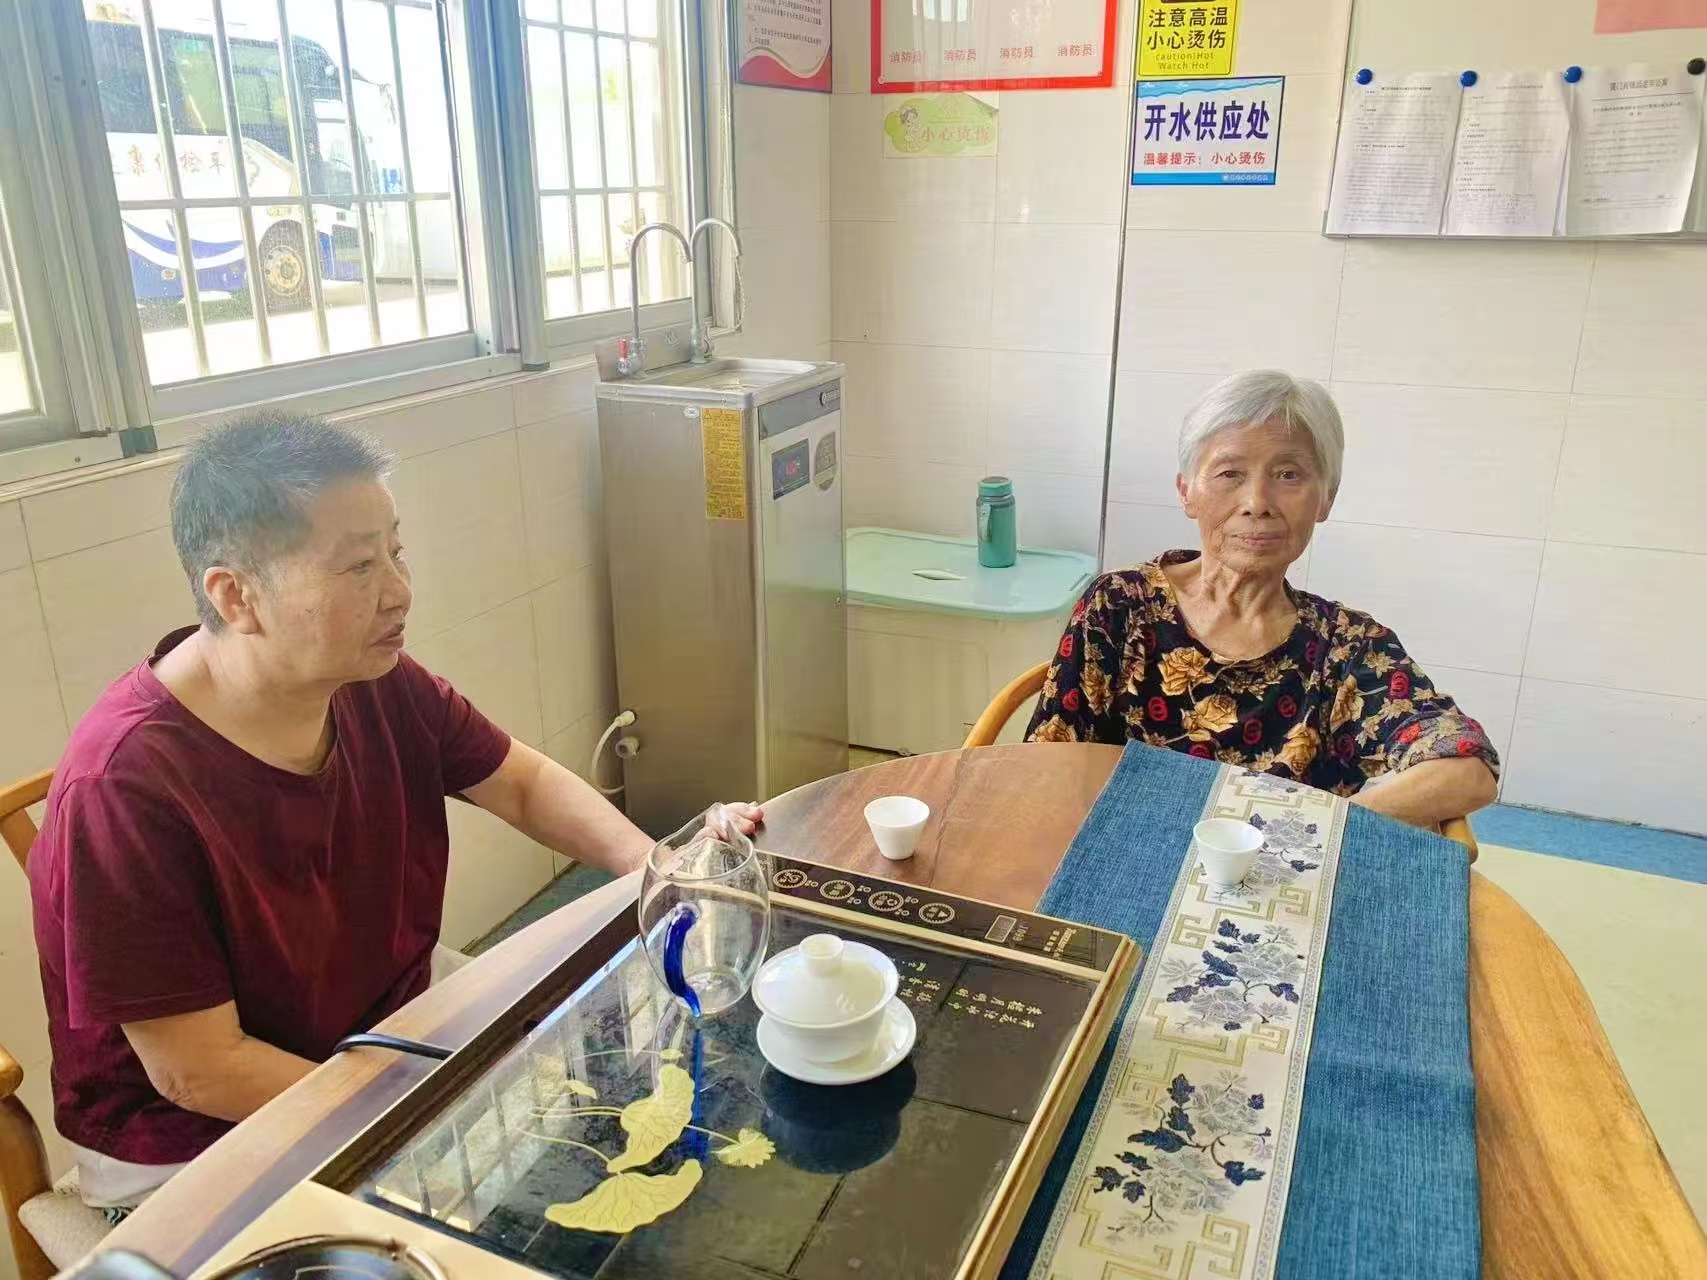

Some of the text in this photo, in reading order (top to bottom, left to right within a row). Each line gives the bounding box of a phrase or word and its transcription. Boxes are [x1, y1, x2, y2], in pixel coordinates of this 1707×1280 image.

[1148, 6, 1228, 28] 注意高温
[1146, 29, 1227, 50] 小心烫伤
[889, 44, 1093, 63] 消防员 消防员 消防员 消防员
[1159, 61, 1209, 70] Watch Hot
[1144, 100, 1270, 142] 开水供应处
